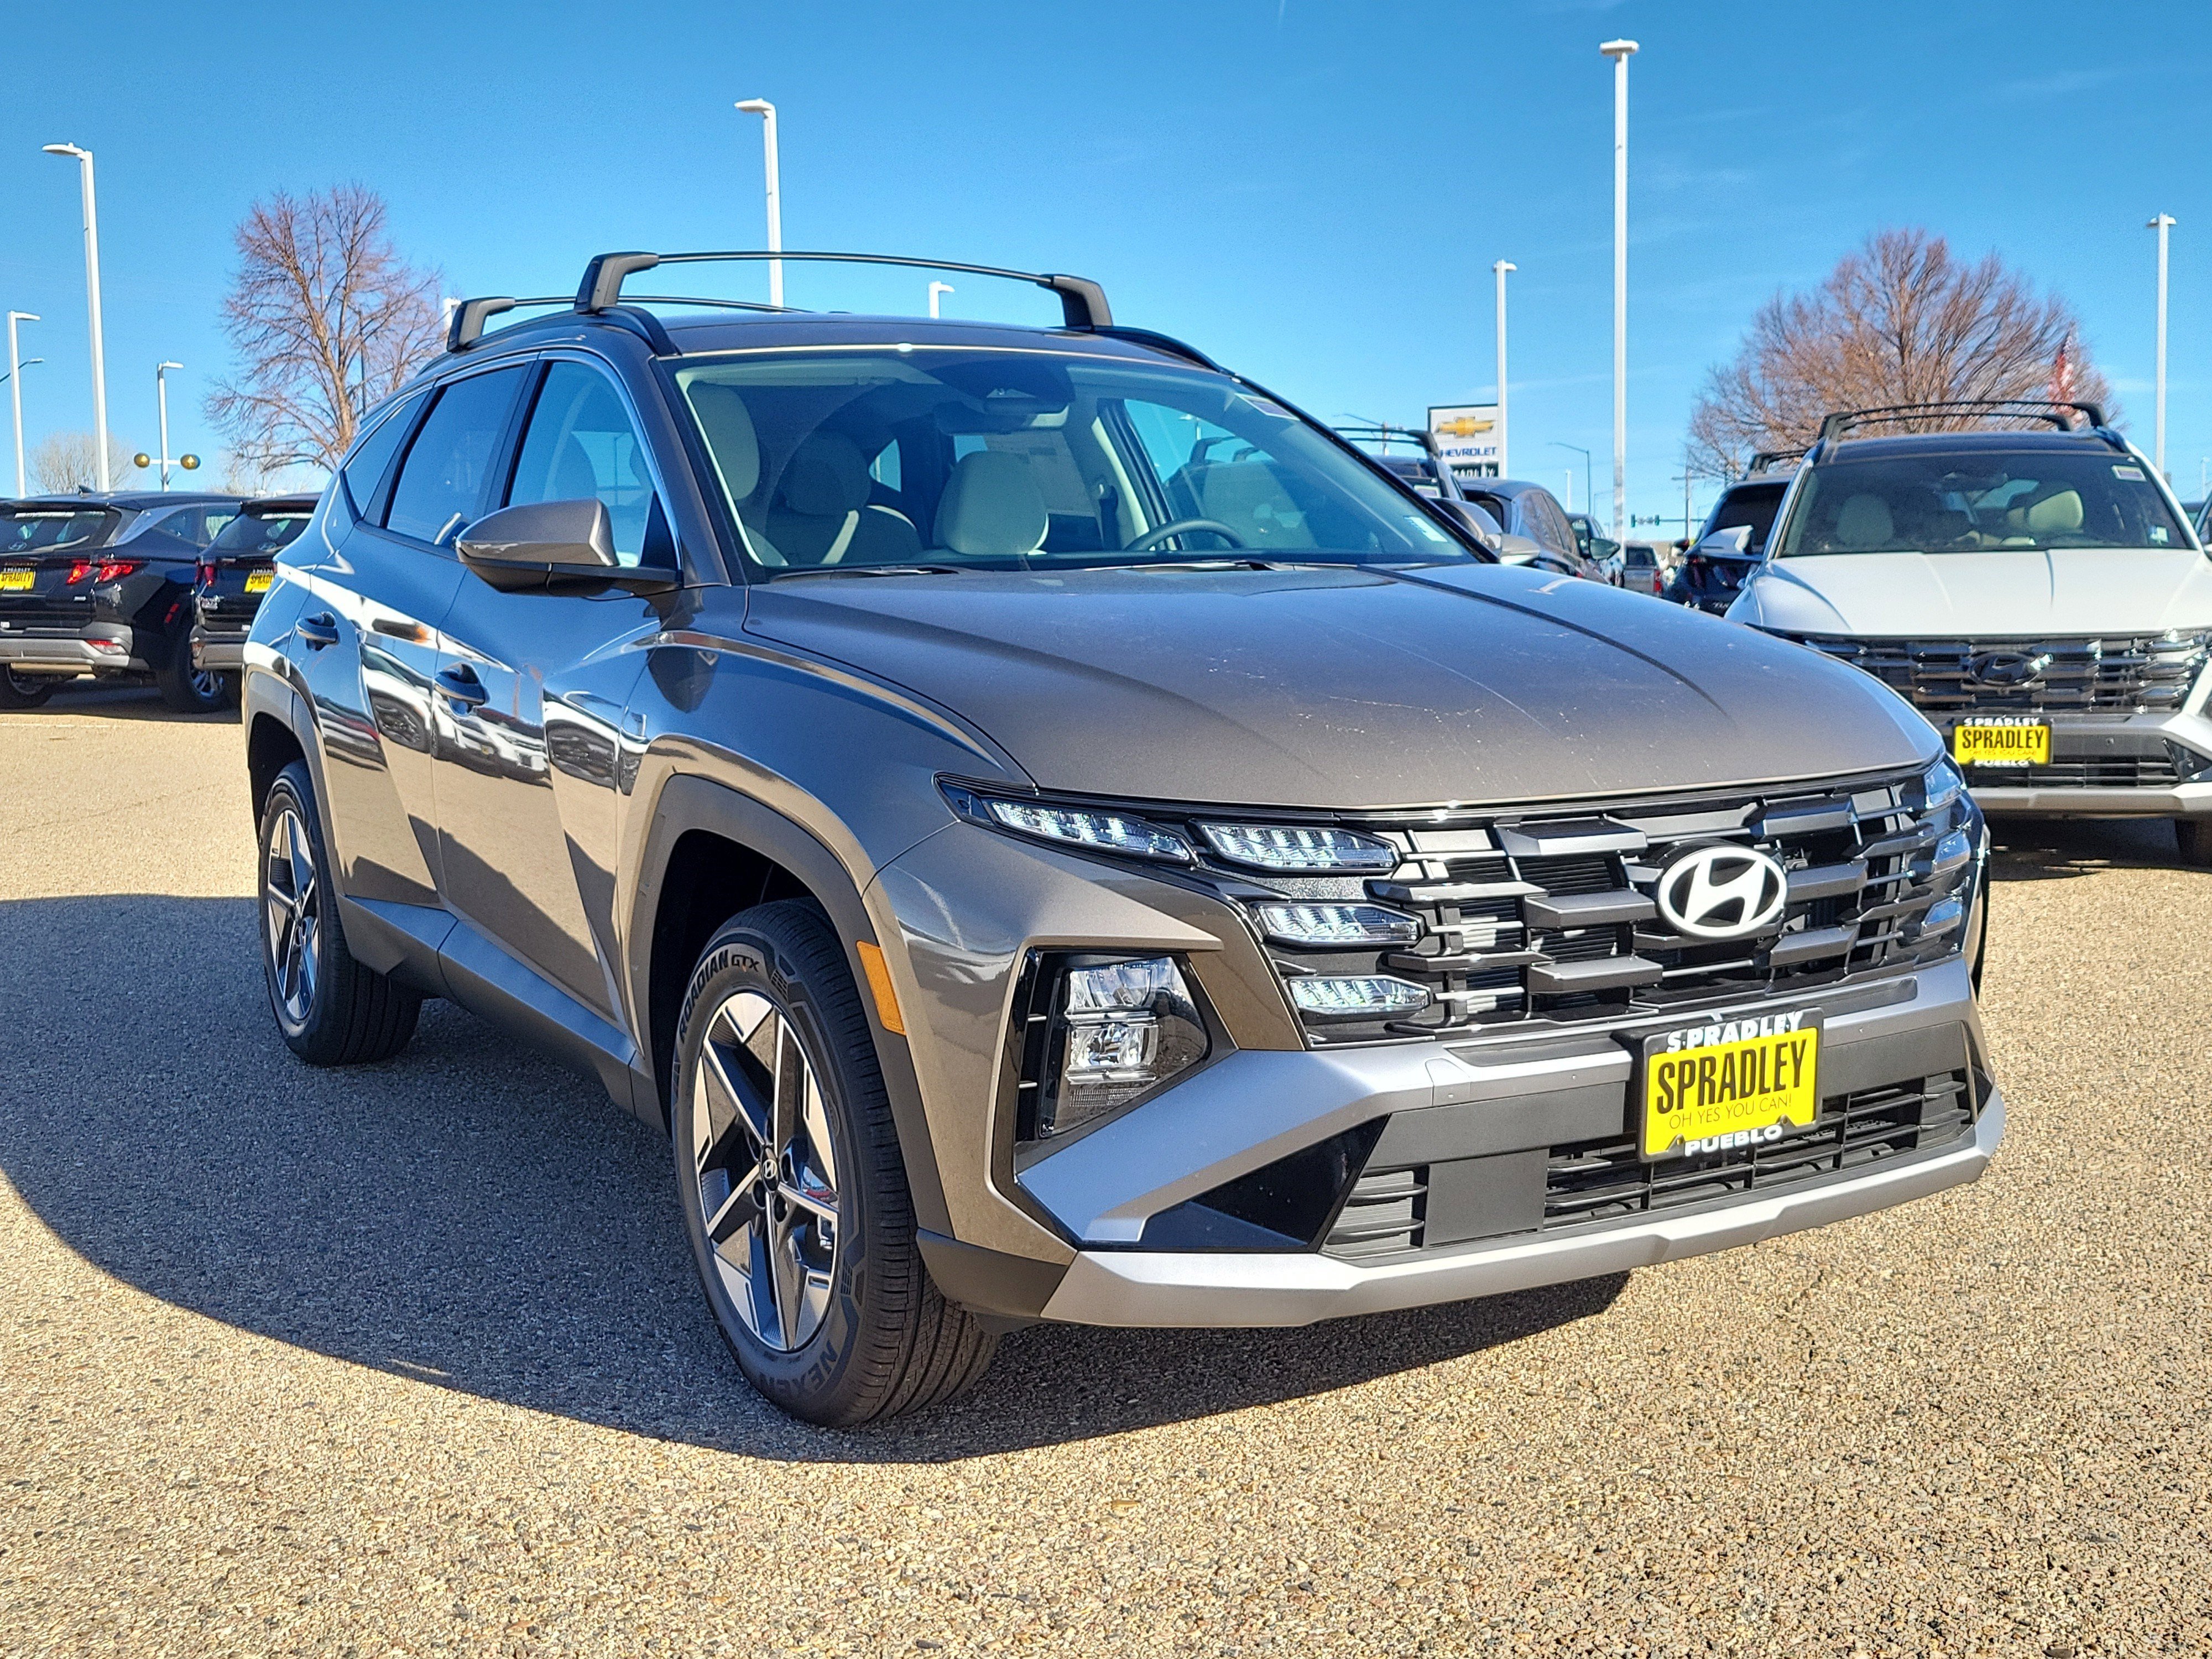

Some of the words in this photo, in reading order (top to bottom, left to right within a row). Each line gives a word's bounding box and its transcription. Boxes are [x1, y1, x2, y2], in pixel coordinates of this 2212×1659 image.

[1962, 729, 2044, 749] SPRADLEY
[679, 950, 729, 1044] ROADIAN
[731, 954, 759, 972] GTX
[1667, 1011, 1804, 1053] SPRADLEY
[1657, 1039, 1807, 1114] SPRADLEY
[1669, 1114, 1691, 1129] OH
[1698, 1108, 1720, 1124] YES
[1727, 1103, 1755, 1118] YOU
[1759, 1093, 1792, 1110] CAN!
[1684, 1124, 1783, 1157] PUEBLO
[759, 1339, 838, 1399] NEXEN
